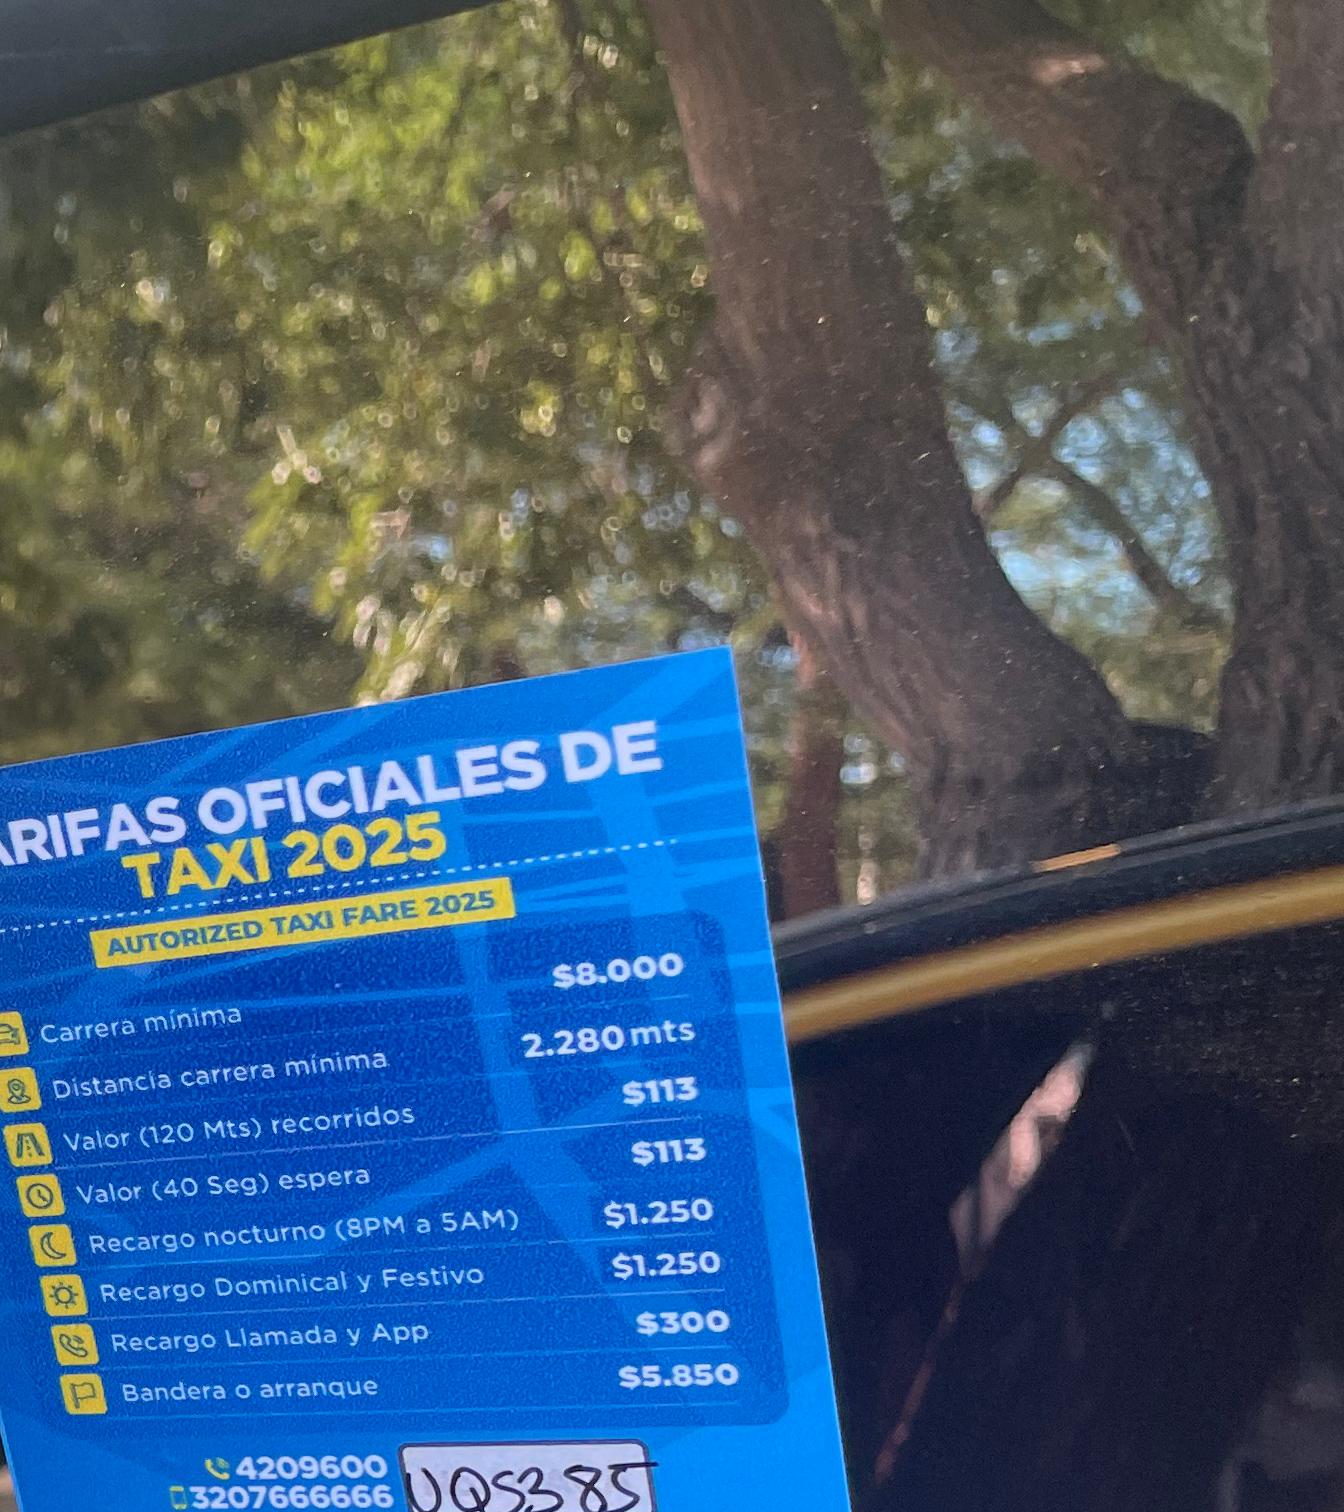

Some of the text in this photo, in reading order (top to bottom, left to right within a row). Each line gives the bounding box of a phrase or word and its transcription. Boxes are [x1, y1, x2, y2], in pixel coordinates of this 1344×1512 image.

[198, 740, 547, 834] OFICIALES
[559, 720, 663, 783] DE
[121, 811, 447, 898] TAXI 2025
[107, 890, 495, 956] AUTORIZED TAXI FARE 2025
[552, 952, 684, 989] $8.000
[40, 1006, 242, 1043] Carrera mínima
[521, 1020, 695, 1058] 2.280 mts
[52, 1050, 387, 1100] Distancia carrera mínima
[622, 1077, 699, 1107] $113
[63, 1105, 415, 1152] Valor (120 Mts) recorridos
[631, 1137, 707, 1167] $113
[76, 1168, 371, 1205] Valor (40 Seg) espera
[89, 1209, 519, 1255] Recargo nocturno (8PM a 5AM)
[604, 1198, 714, 1229] $1.250
[612, 1251, 721, 1280] $1.250
[100, 1266, 484, 1303] Recargo Dominical y Festivo
[111, 1322, 430, 1353] Recargo Llamada y App
[636, 1309, 730, 1337] $300
[122, 1378, 379, 1402] Bandera o arranque
[618, 1363, 739, 1390] $5.850
[235, 1455, 388, 1480] 4209600
[189, 1484, 395, 1510] 3207666666
